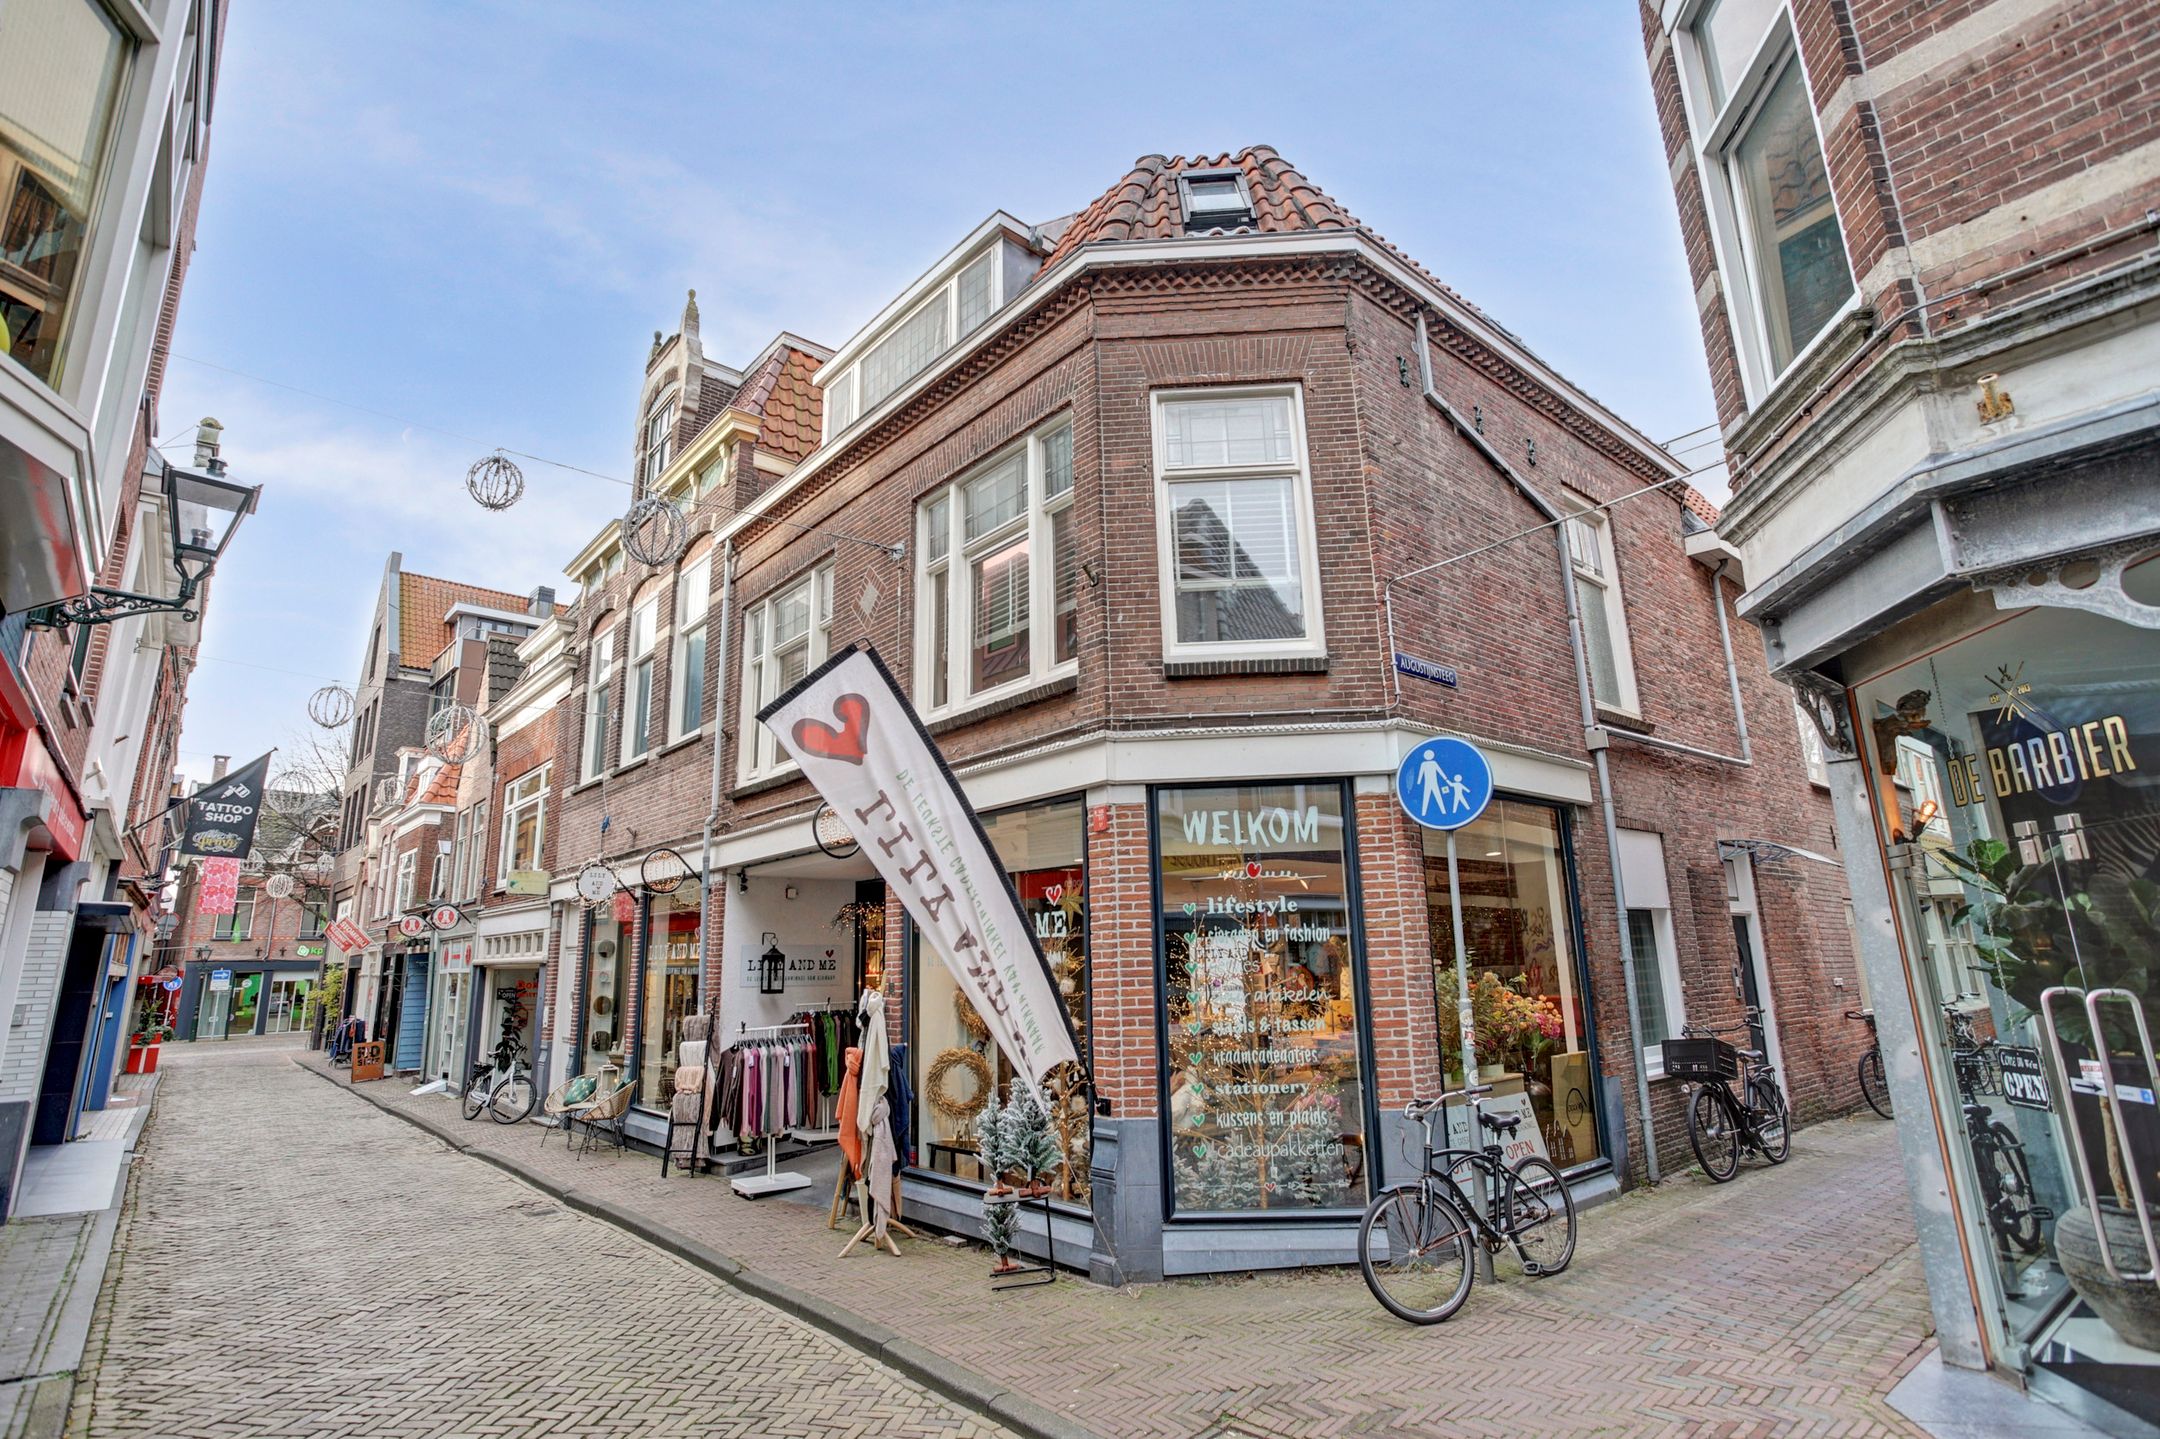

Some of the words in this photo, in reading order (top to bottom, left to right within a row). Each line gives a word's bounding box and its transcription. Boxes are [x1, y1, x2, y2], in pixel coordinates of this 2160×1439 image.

[1947, 753, 1985, 808] DE
[1987, 715, 2137, 798] BARBIER
[199, 801, 253, 815] TATTOO
[204, 812, 243, 824] SHOP
[1183, 805, 1319, 848] WELKOM
[1206, 895, 1299, 916] lifestyle
[1034, 909, 1068, 939] ME
[1264, 928, 1279, 943] en
[1284, 922, 1331, 942] fashion
[789, 960, 815, 971] AND
[819, 960, 836, 970] ME
[1254, 984, 1336, 1002] artikelen
[1259, 1016, 1271, 1033] &
[1275, 1016, 1327, 1032] tassen
[1215, 1079, 1310, 1096] stationery
[2003, 1071, 2047, 1102] OPEN
[1216, 1110, 1264, 1127] kussens
[1269, 1111, 1285, 1126] en
[1289, 1106, 1328, 1129] plaids
[1217, 1132, 1345, 1158] cadeaupakketten
[1505, 1140, 1535, 1160] OPEN
